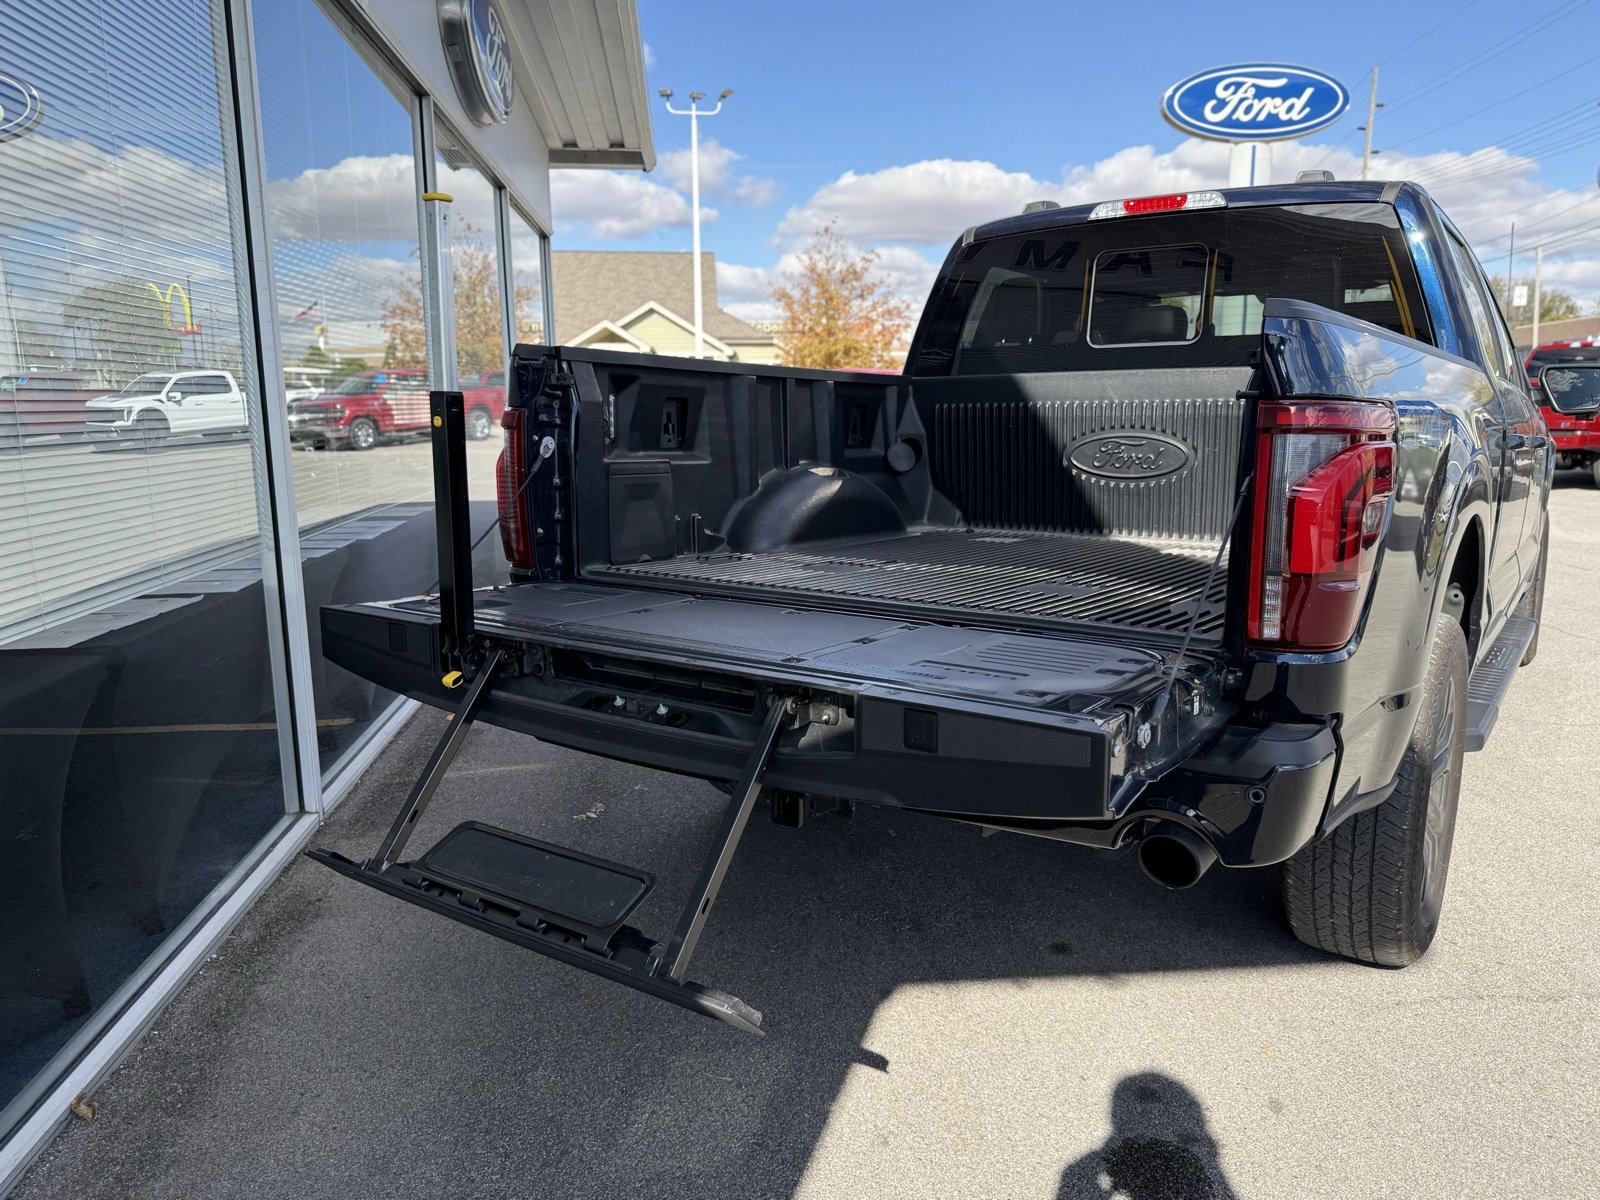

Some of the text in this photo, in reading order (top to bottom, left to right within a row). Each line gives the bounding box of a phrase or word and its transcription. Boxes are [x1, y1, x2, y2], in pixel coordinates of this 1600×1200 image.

[486, 6, 512, 101] Ford
[1203, 77, 1315, 124] Ford
[1092, 438, 1165, 470] Ford
